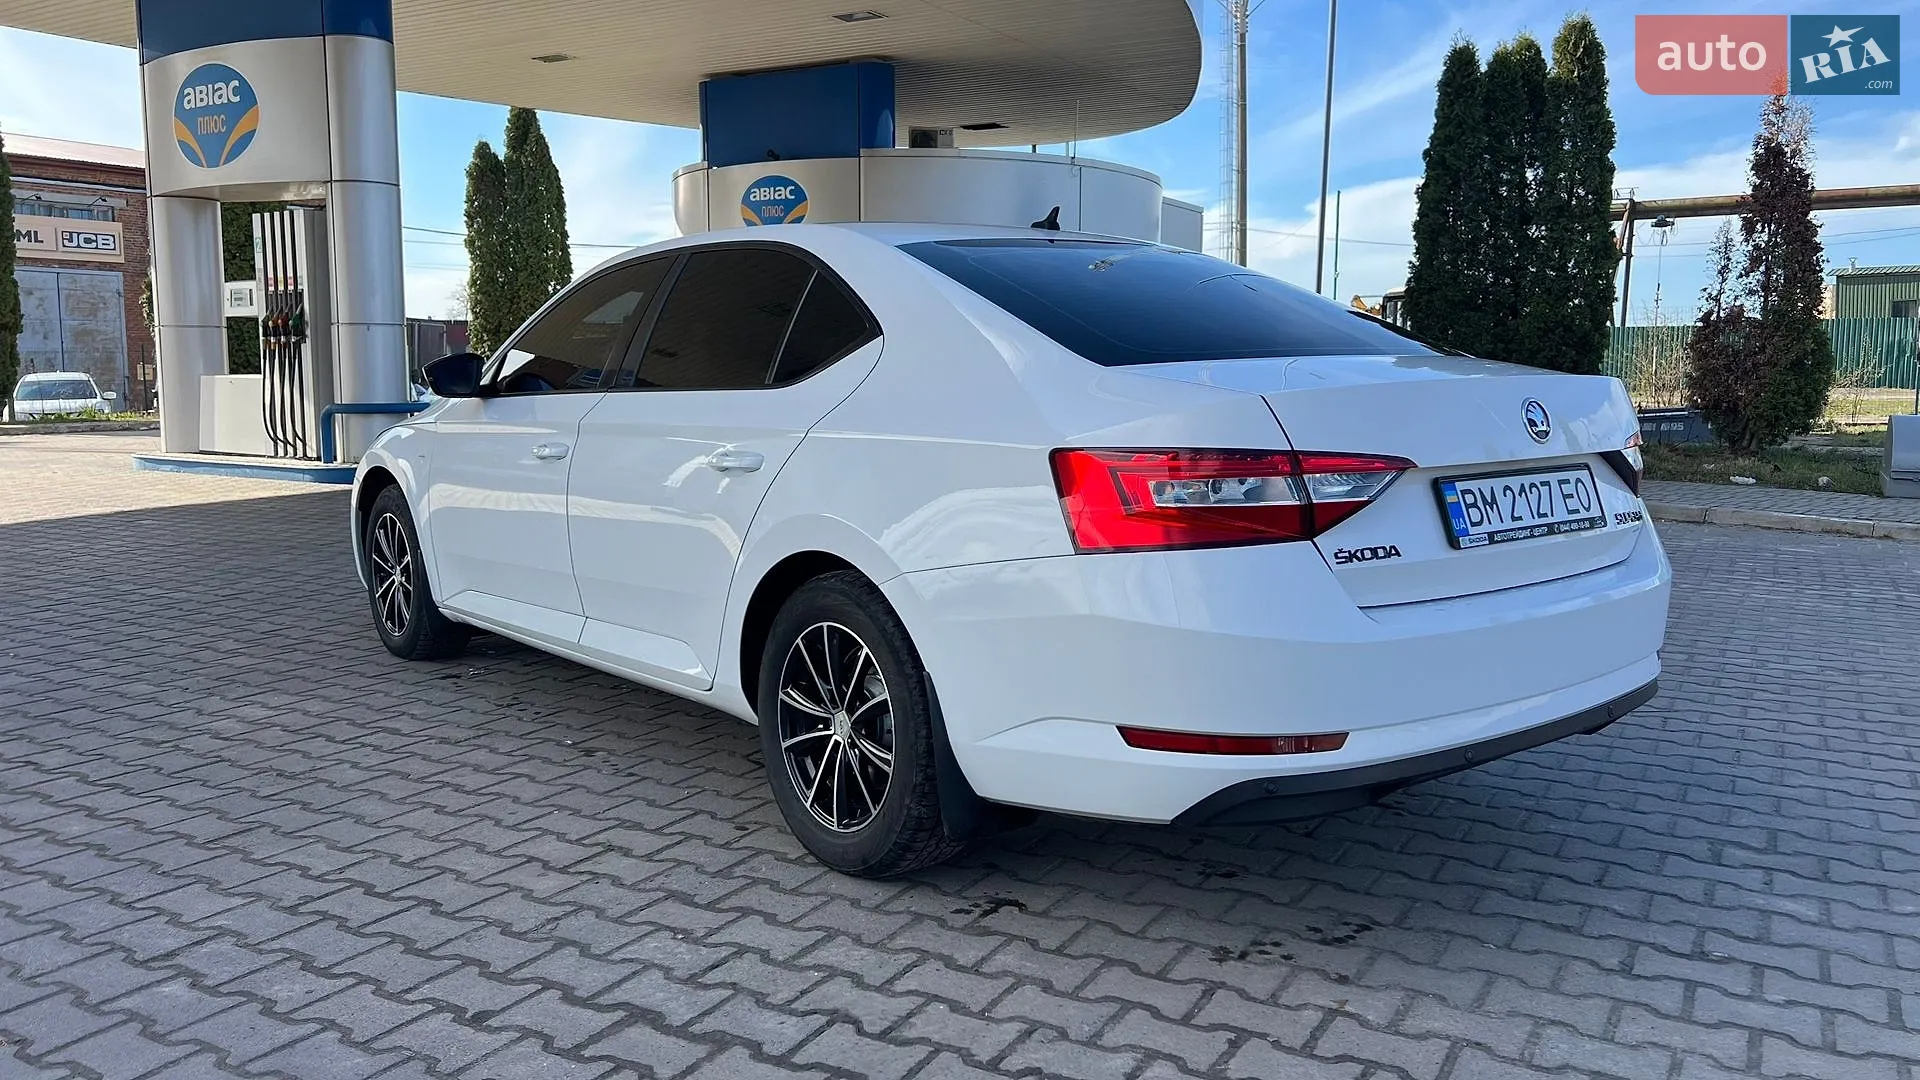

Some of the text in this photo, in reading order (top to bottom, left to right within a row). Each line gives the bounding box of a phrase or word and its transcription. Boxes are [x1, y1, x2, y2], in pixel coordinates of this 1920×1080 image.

[63, 232, 115, 249] JCB
[1460, 477, 1592, 527] BM 2127 EO
[1453, 518, 1466, 530] UA
[1334, 545, 1402, 565] ŠKODA
